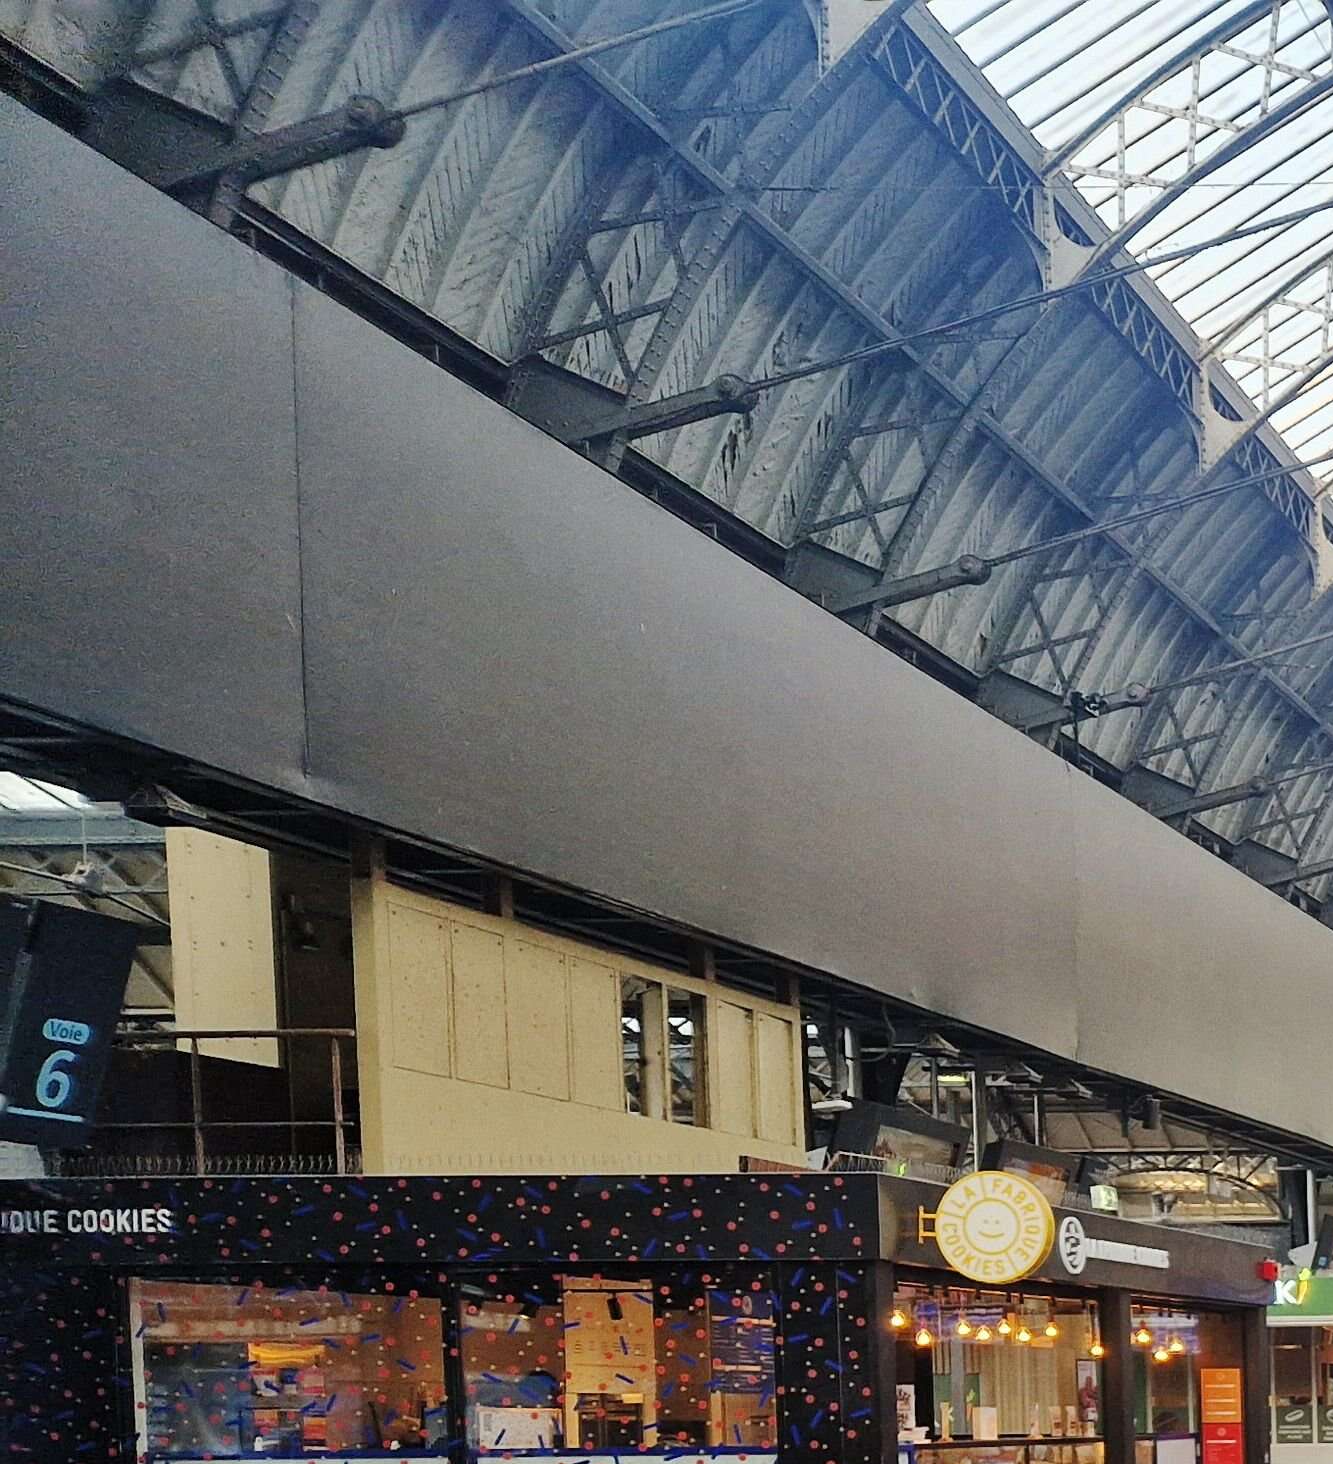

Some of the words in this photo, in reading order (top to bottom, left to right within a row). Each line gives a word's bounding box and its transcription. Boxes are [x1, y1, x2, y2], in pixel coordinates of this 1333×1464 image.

[49, 1020, 83, 1041] Voie
[36, 1050, 76, 1107] 6
[955, 1186, 976, 1212] LA
[67, 1209, 172, 1233] COOKIES
[942, 1223, 1006, 1276] COOKIES
